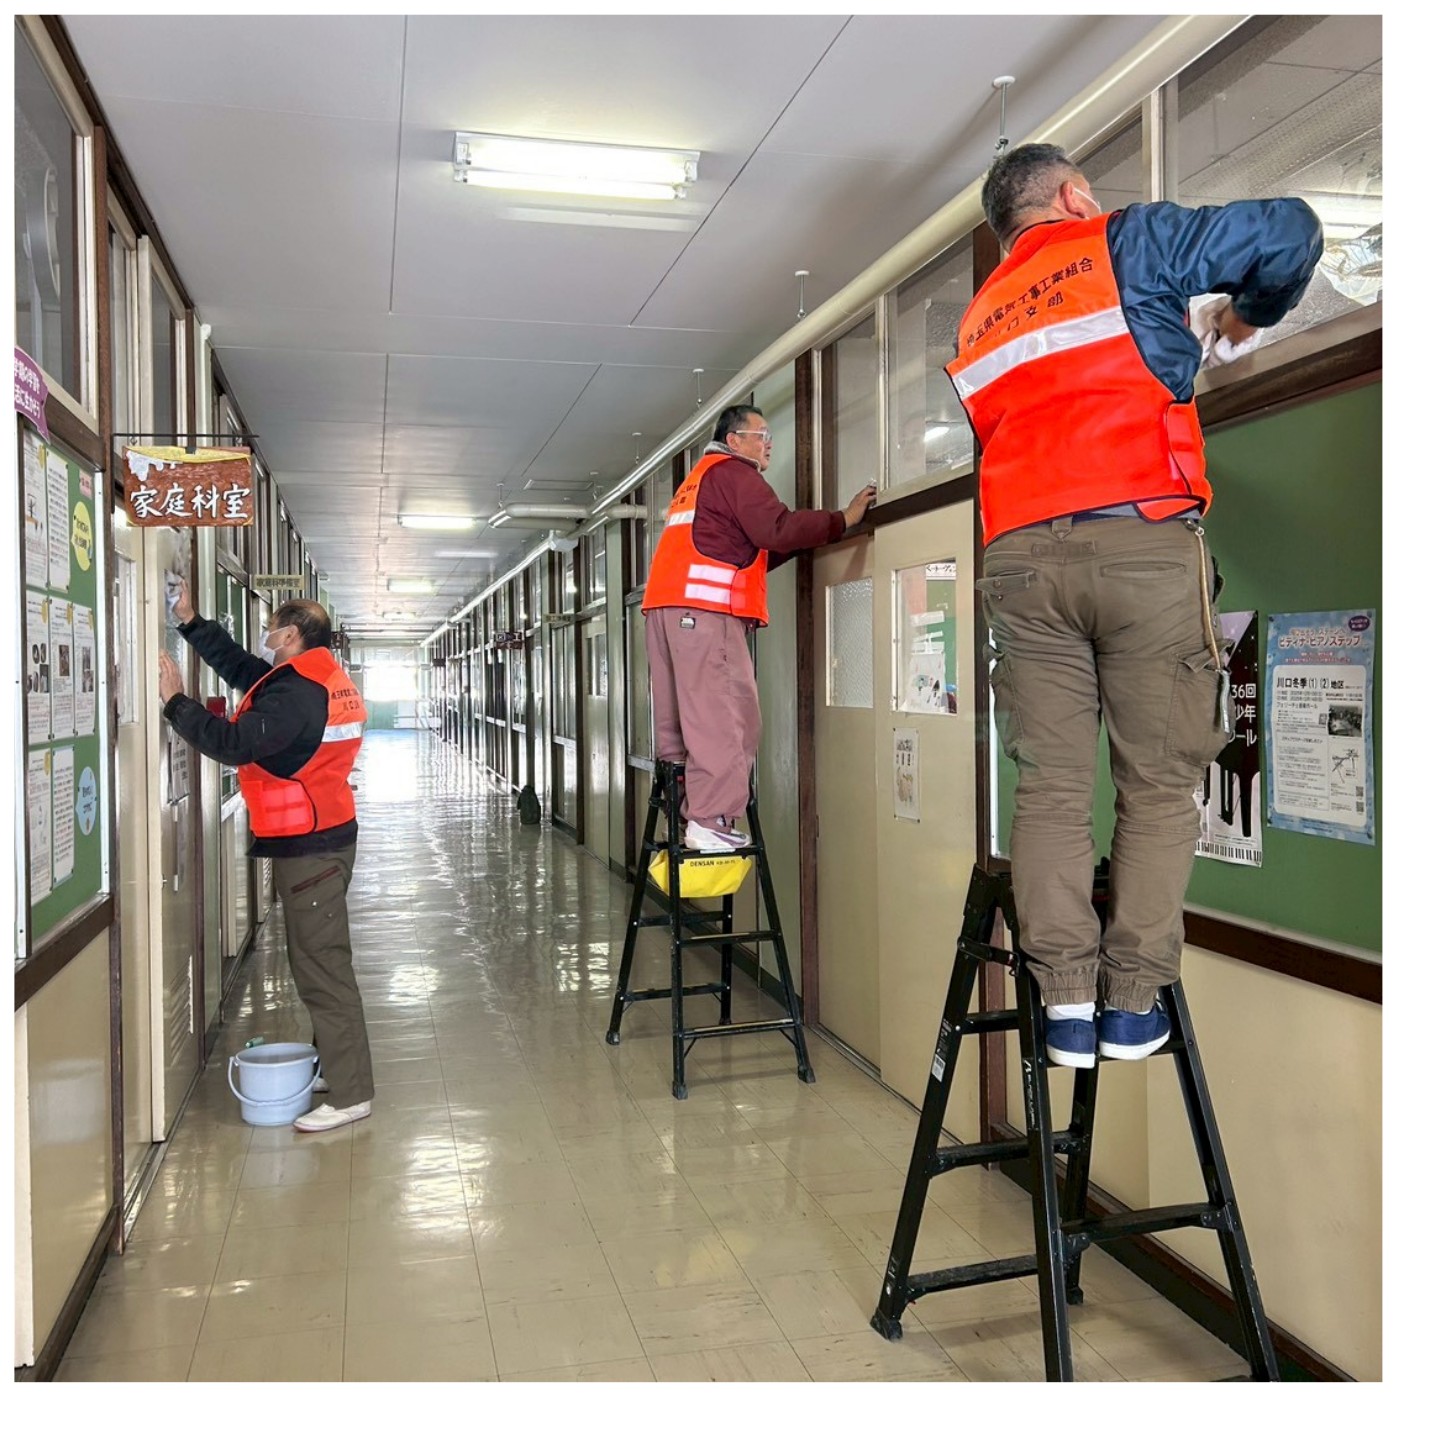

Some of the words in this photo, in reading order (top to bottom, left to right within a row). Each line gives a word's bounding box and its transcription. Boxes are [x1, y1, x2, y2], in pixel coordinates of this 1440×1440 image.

[130, 482, 251, 519] 家庭科室
[1231, 683, 1257, 699] 36回
